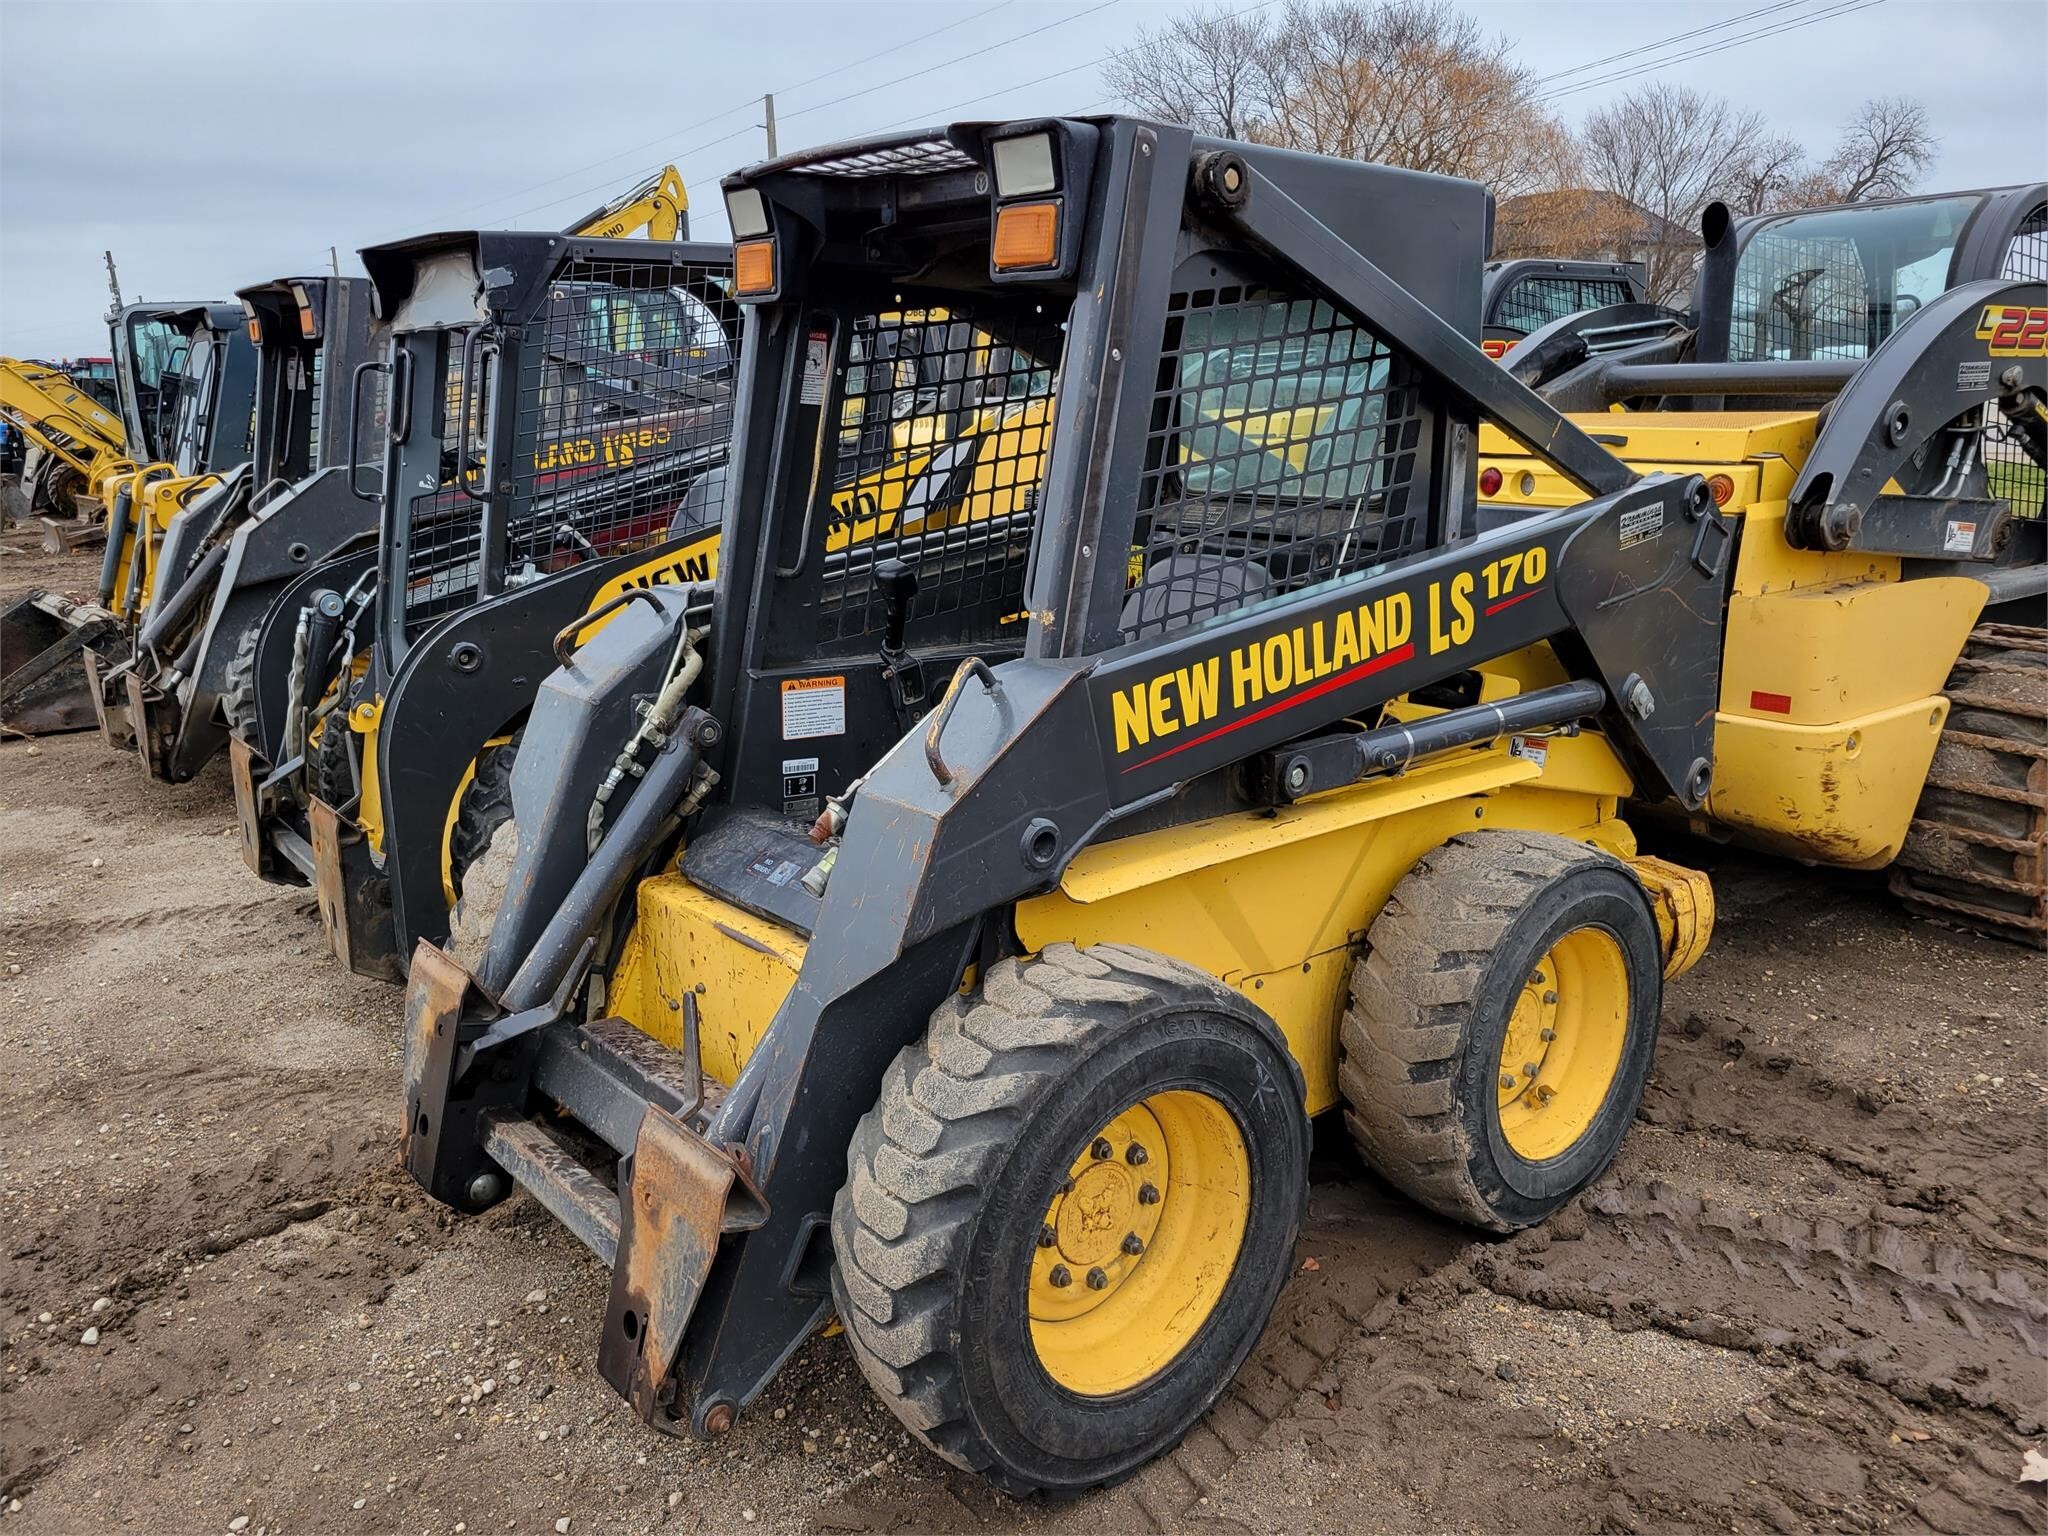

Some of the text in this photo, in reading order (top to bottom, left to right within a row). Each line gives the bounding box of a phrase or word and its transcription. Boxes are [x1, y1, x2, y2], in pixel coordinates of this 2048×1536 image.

[1976, 307, 2047, 351] L22
[1111, 546, 1548, 753] NEW HOLLAND LS 170
[799, 678, 838, 688] WARNING
